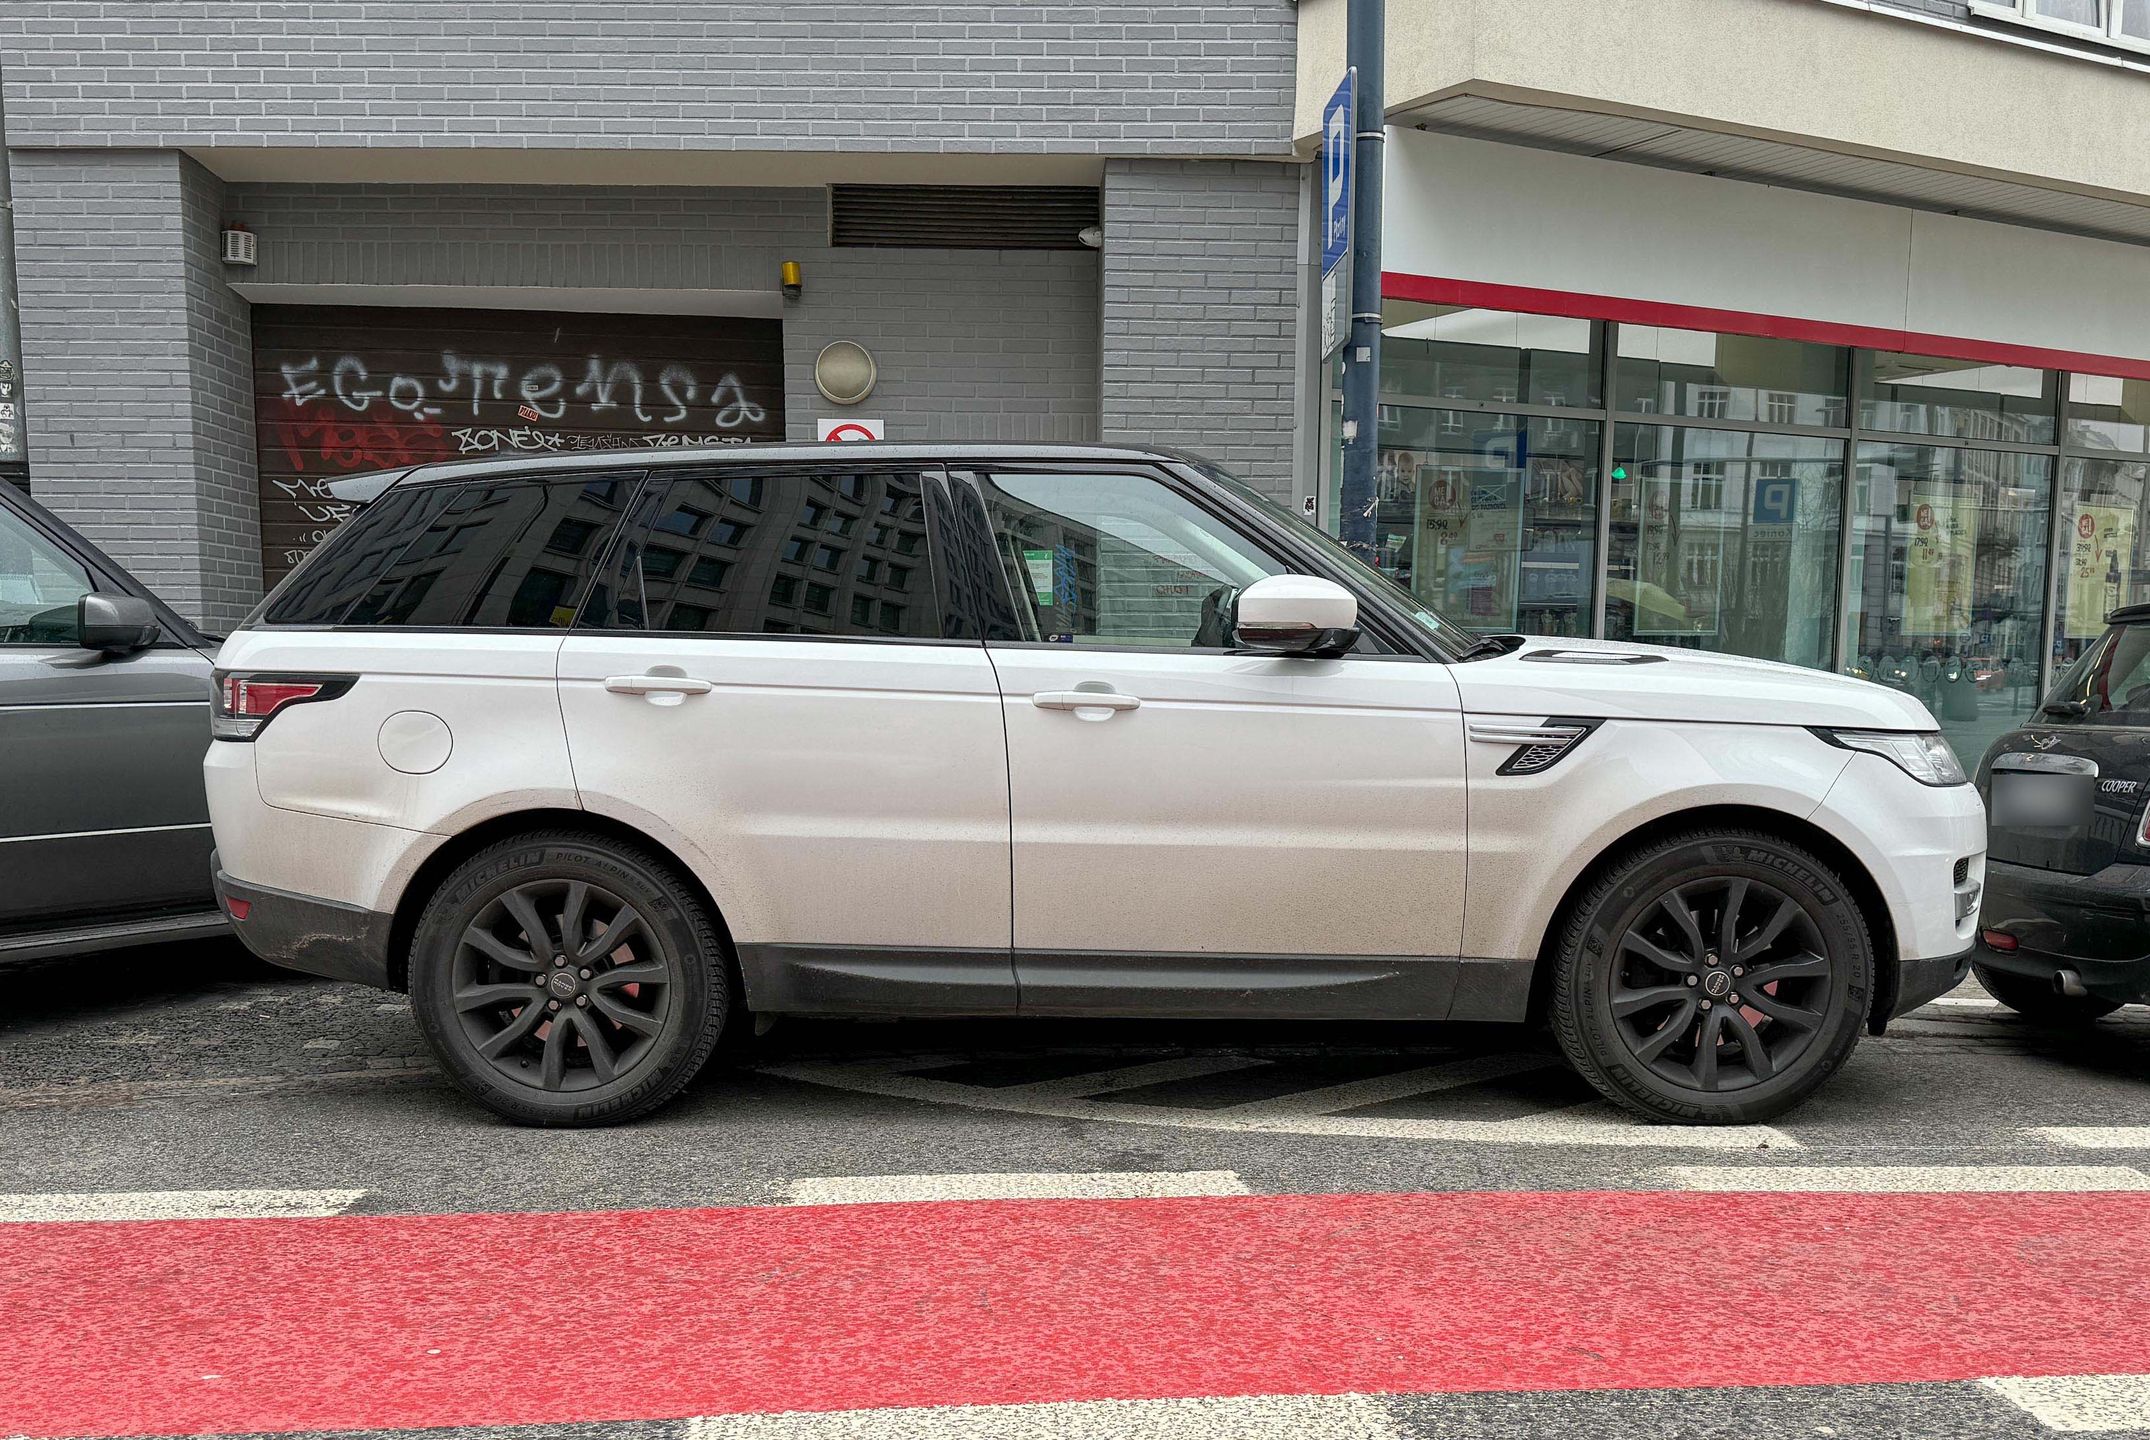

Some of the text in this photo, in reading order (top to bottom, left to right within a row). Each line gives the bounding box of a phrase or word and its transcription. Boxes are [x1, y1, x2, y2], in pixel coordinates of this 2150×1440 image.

[1328, 103, 1344, 250] P
[2101, 780, 2137, 793] COOPER
[455, 851, 542, 901] MICHELIN
[555, 852, 591, 866] PILOT
[1747, 850, 1836, 905] MICHELIN
[1609, 1064, 1703, 1119] MICHELIN
